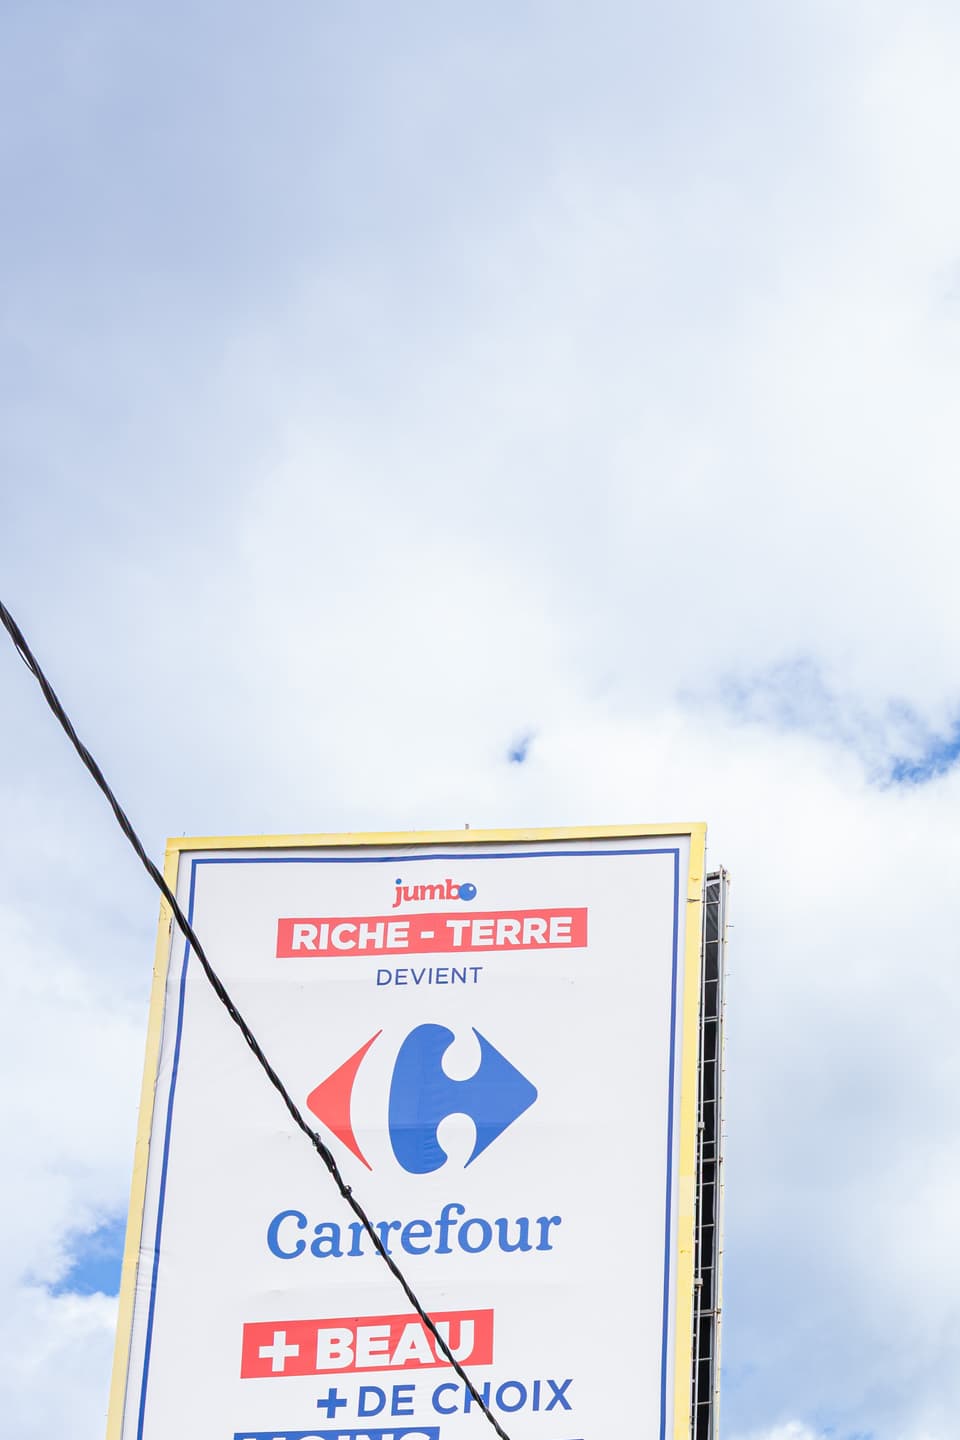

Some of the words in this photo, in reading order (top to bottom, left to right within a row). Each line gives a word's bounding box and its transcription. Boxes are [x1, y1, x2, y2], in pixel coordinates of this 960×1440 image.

[392, 878, 477, 908] jumbo
[291, 921, 410, 950] RICHE
[446, 916, 572, 947] TERRE
[376, 966, 483, 986] DEVIENT
[267, 1202, 562, 1260] Carrefour
[315, 1319, 476, 1371] BEAU
[357, 1384, 417, 1417] DE
[432, 1378, 574, 1416] CHOIX
